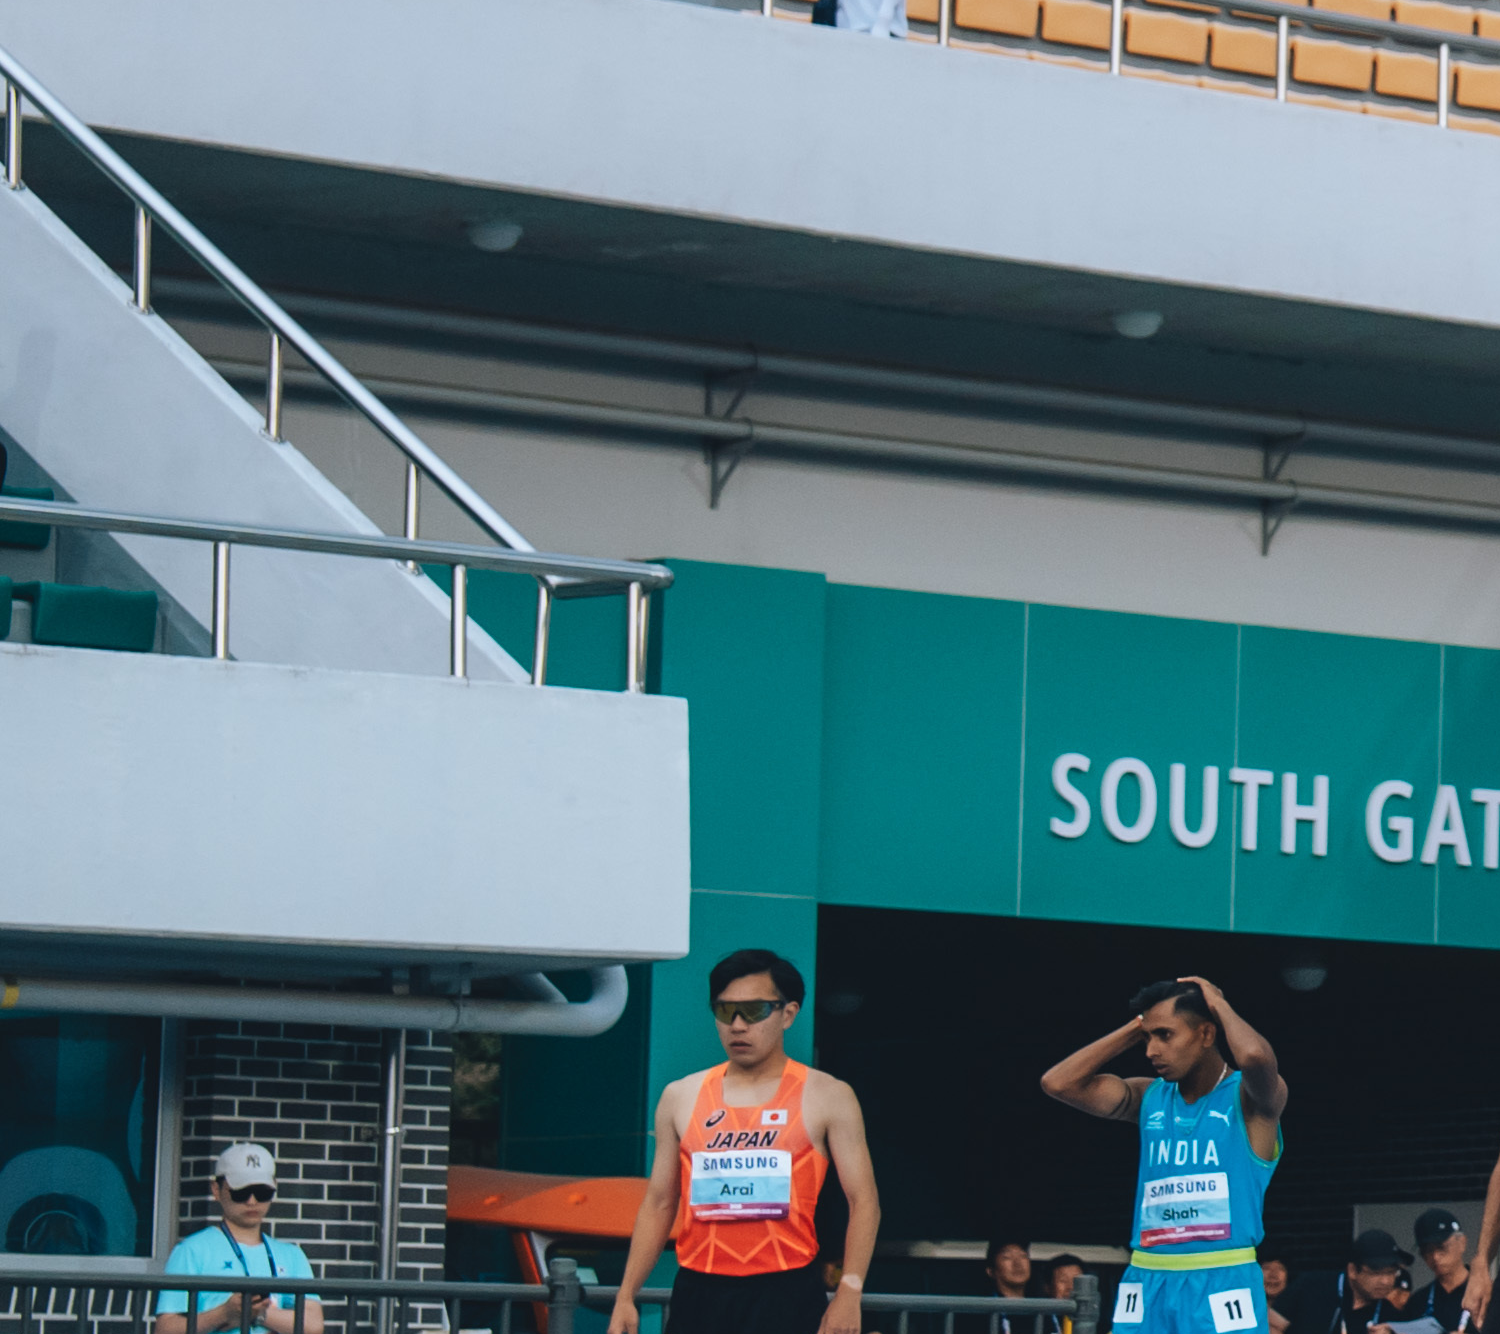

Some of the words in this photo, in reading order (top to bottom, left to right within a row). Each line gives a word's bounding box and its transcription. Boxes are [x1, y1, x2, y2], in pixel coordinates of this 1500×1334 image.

[1049, 752, 1330, 857] SOUTH
[707, 1129, 778, 1149] JAPAN
[1148, 1138, 1220, 1166] INDIA
[703, 1156, 778, 1170] SAMSUNG
[720, 1182, 754, 1197] Arai
[1150, 1180, 1217, 1199] SAMSUNG
[1162, 1206, 1199, 1222] Shah
[1126, 1292, 1138, 1313] 11
[1224, 1299, 1243, 1320] 11
